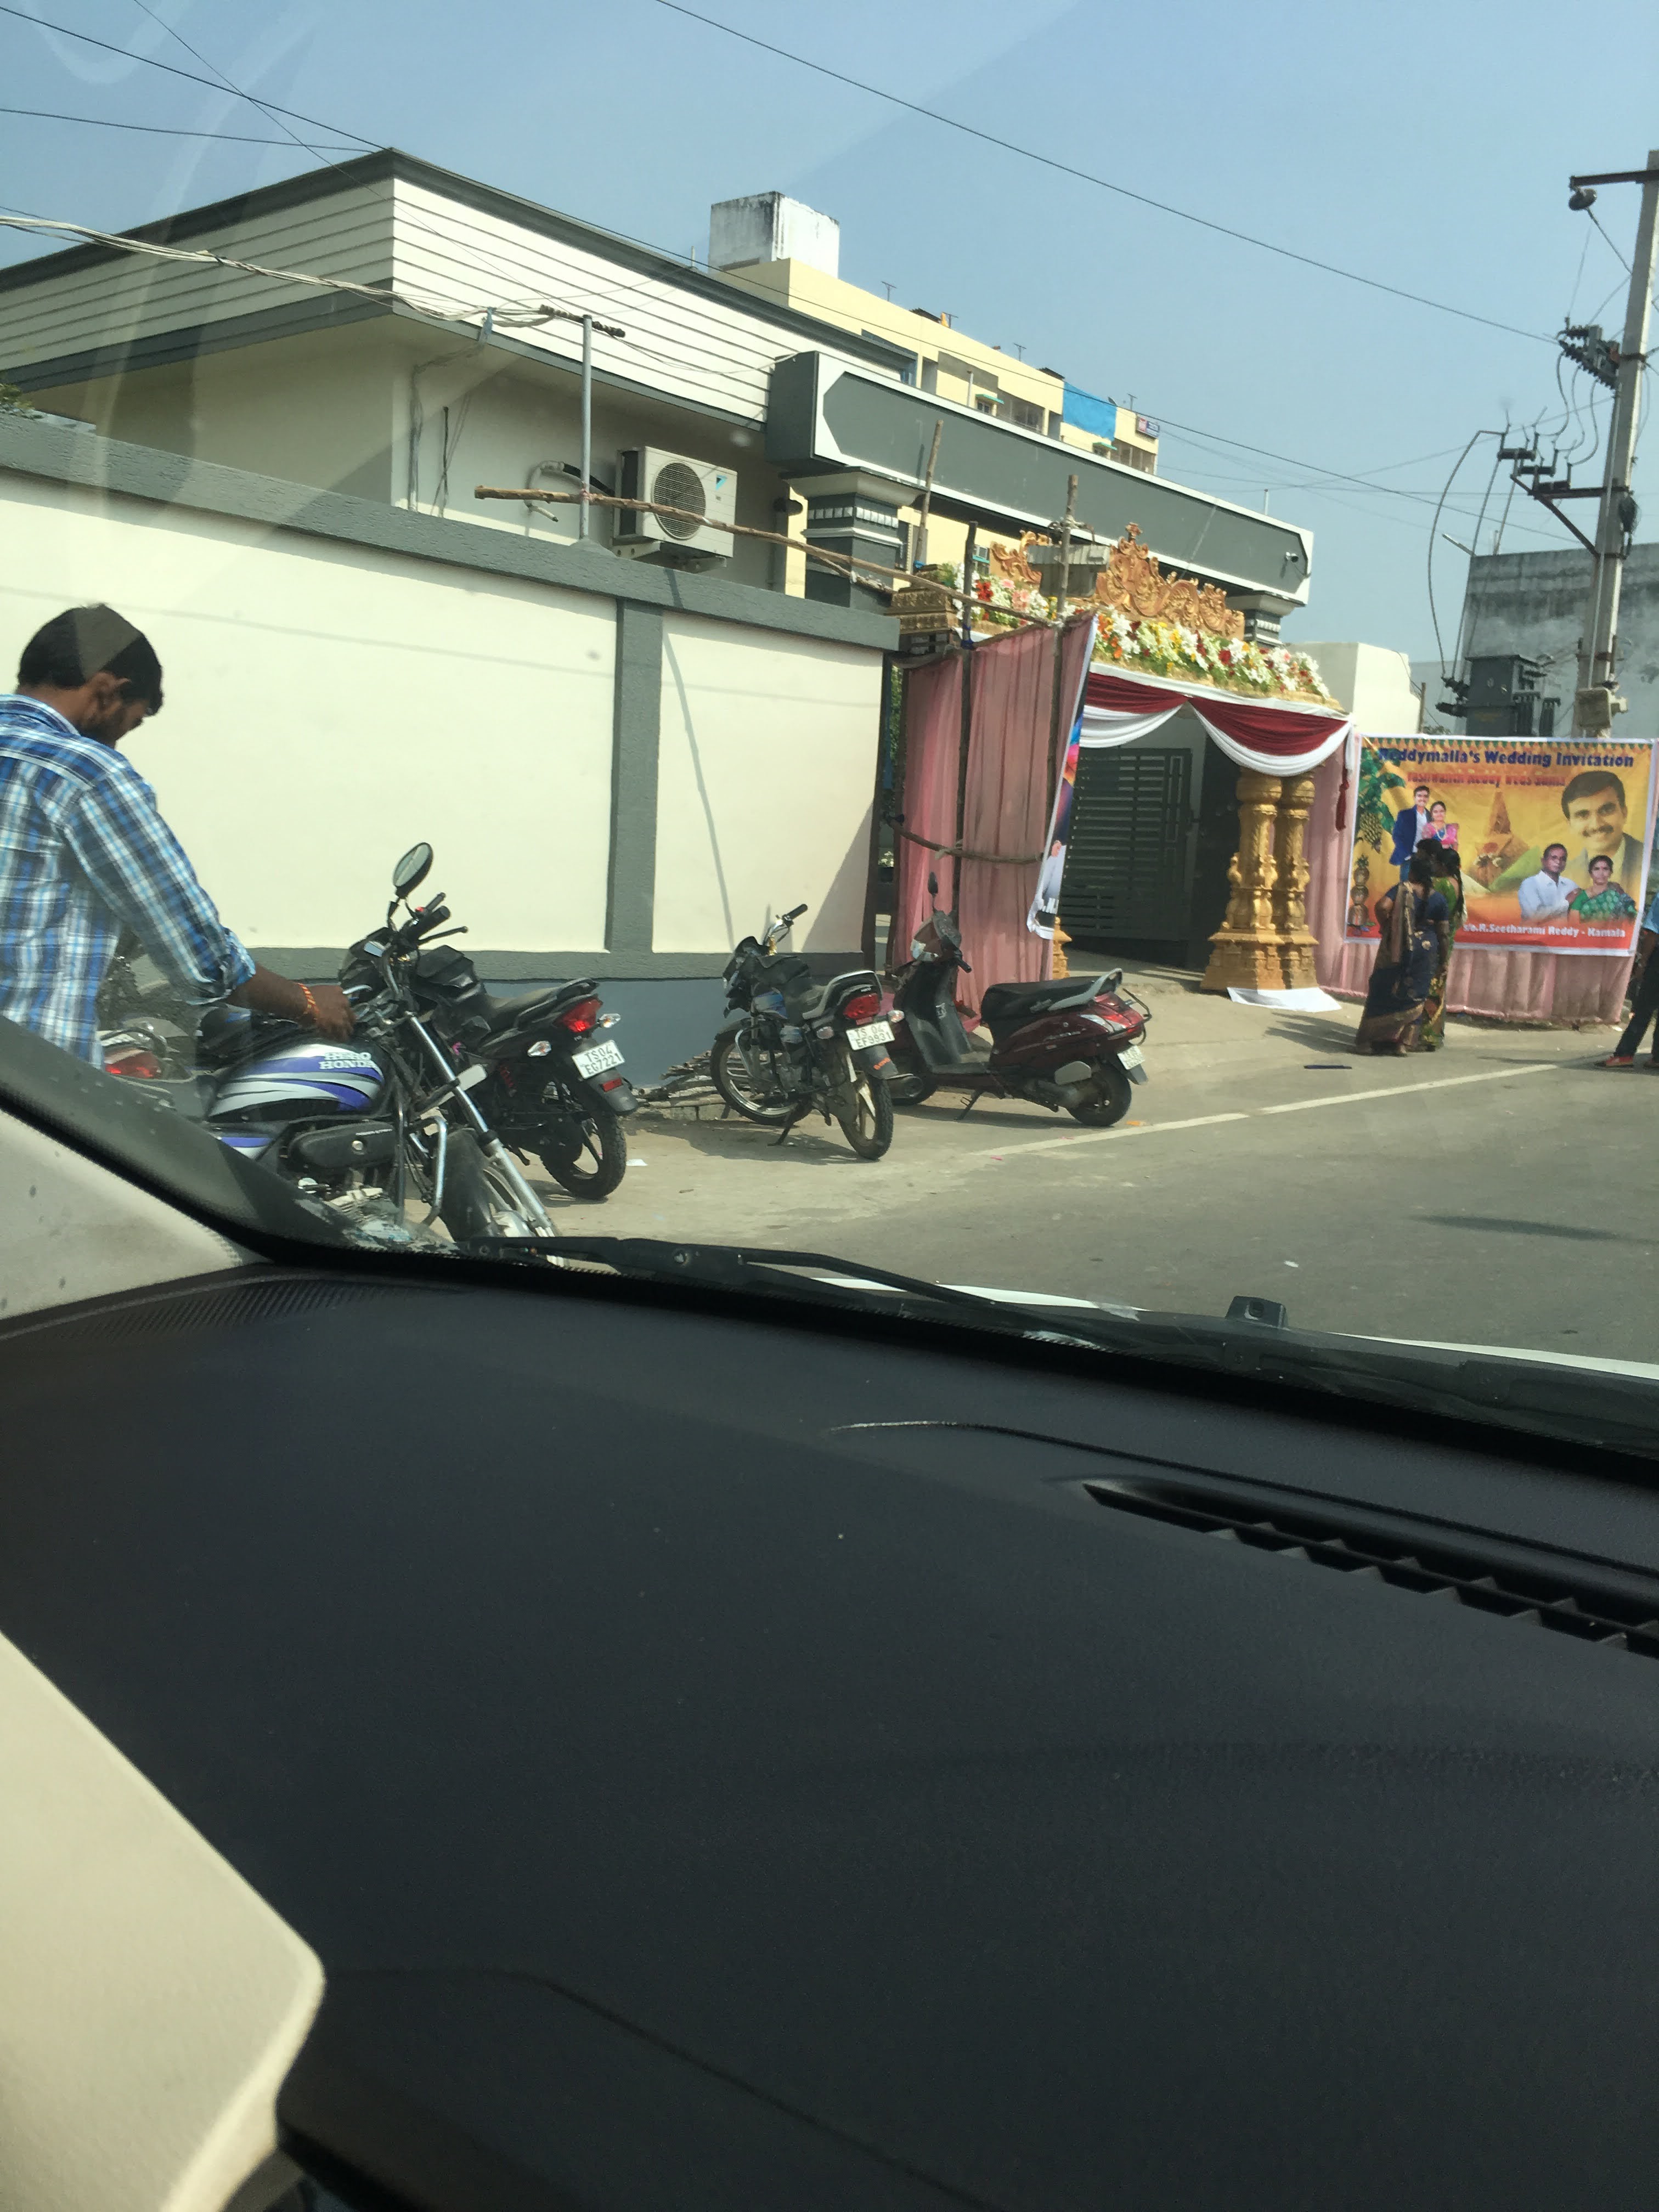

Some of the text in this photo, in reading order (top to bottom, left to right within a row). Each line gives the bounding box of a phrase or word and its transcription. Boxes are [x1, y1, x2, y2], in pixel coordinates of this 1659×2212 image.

[1485, 751, 1551, 768] Wedding
[1556, 752, 1634, 767] Invitation
[1548, 926, 1579, 938] Reddy
[324, 1052, 372, 1060] HERO
[319, 1060, 377, 1070] HONDA
[584, 1053, 622, 1075] EG7221
